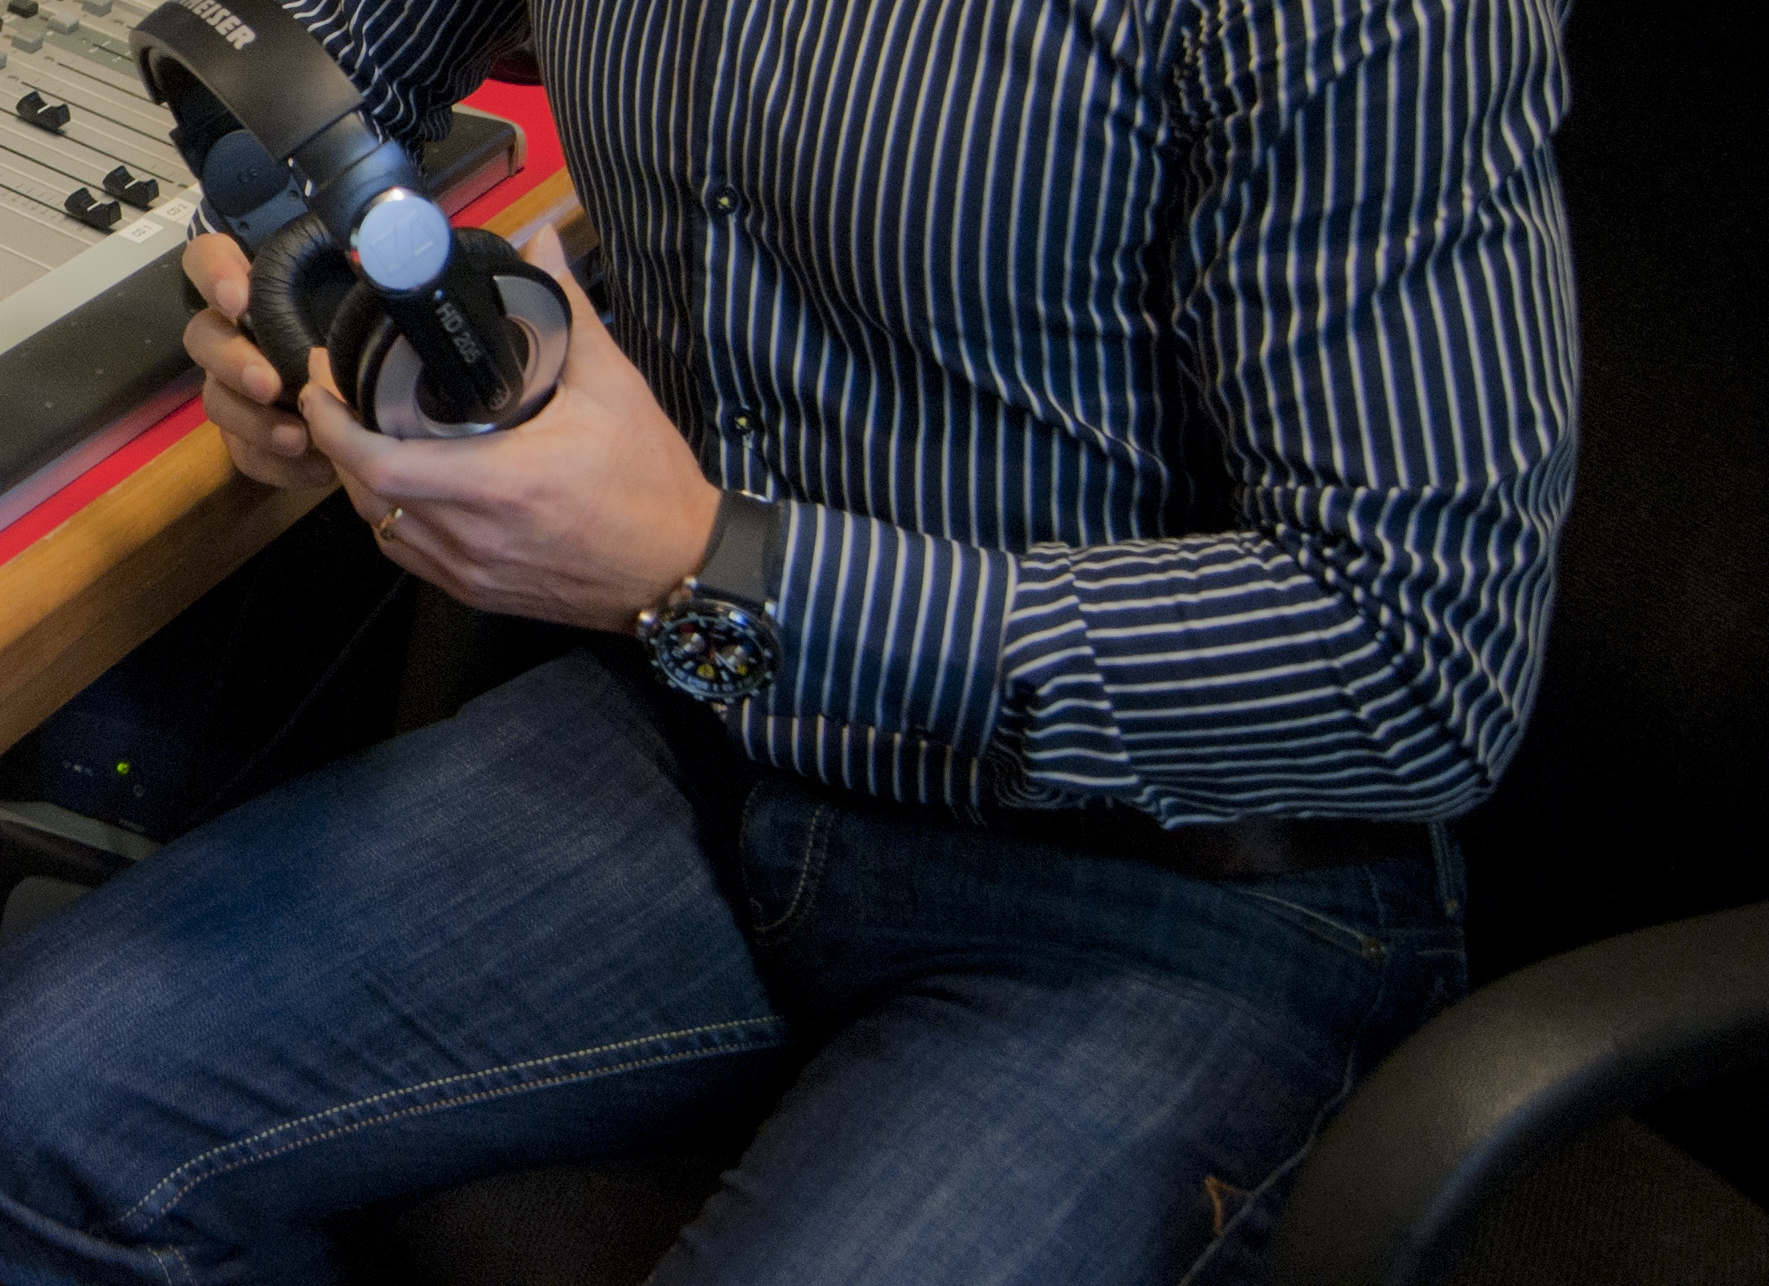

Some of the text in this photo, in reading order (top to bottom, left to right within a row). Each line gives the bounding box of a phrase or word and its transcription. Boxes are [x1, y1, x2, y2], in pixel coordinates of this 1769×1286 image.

[167, 206, 181, 216] CD
[132, 227, 146, 238] CD
[435, 301, 481, 365] HD 205
